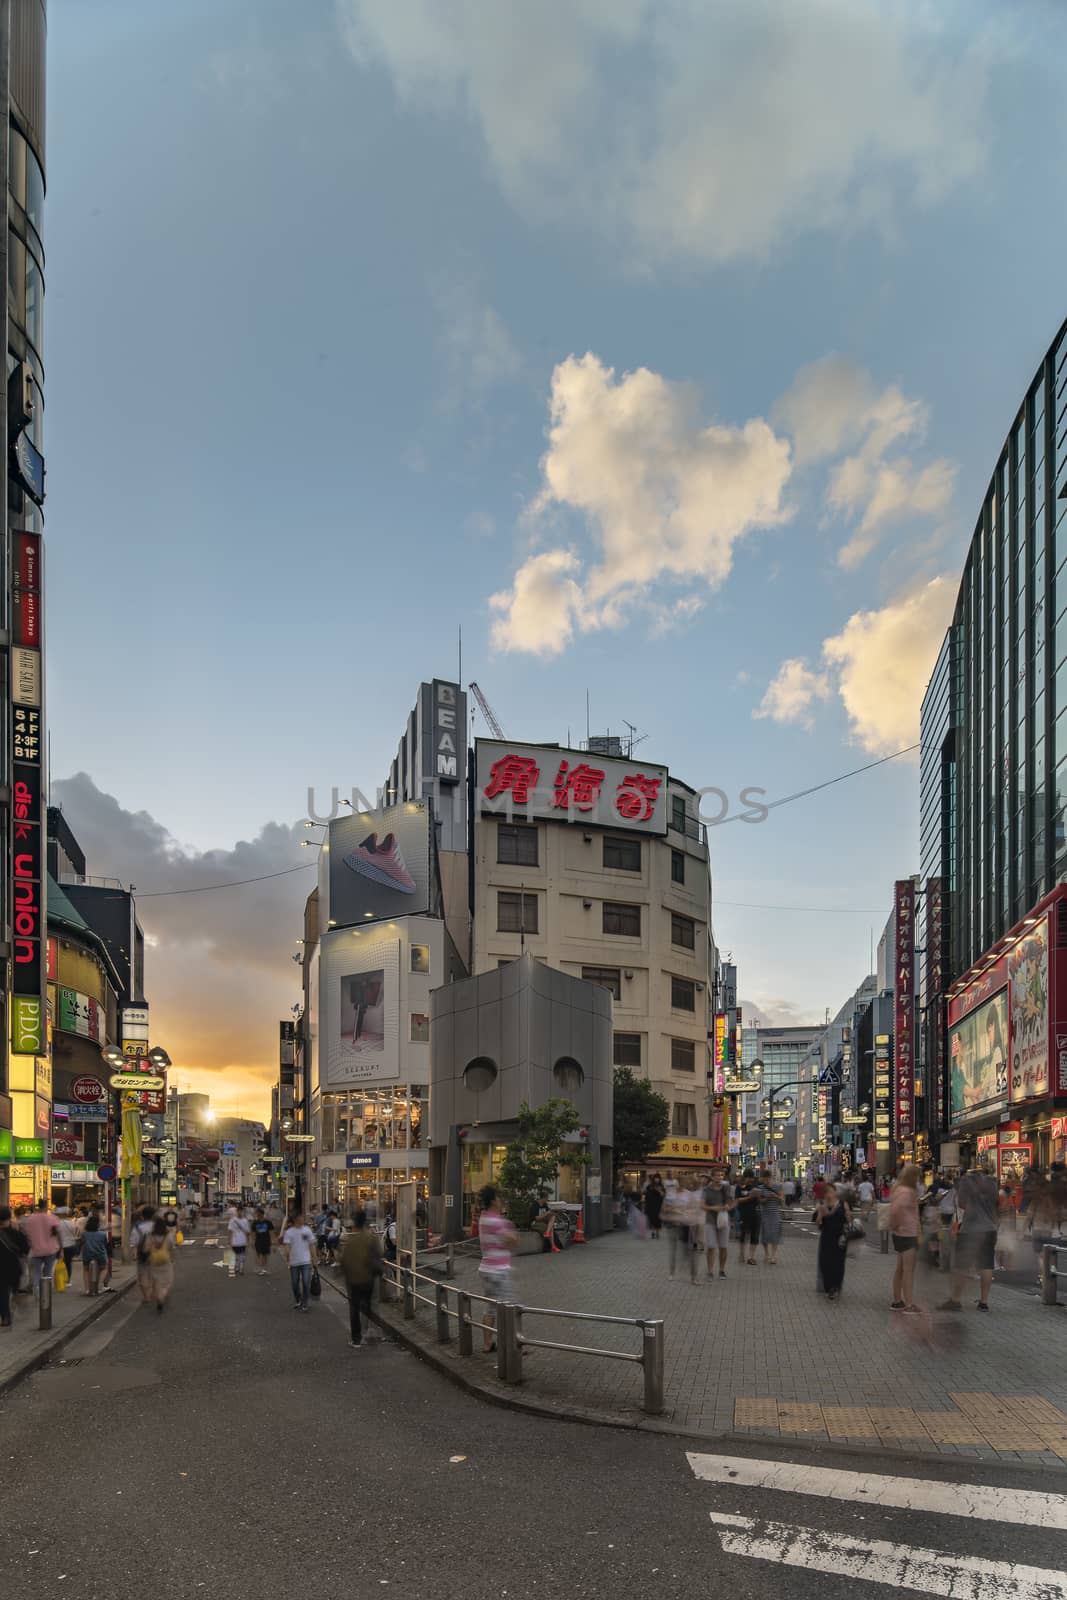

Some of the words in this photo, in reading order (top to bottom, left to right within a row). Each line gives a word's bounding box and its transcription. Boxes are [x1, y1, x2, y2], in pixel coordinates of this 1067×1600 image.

[19, 671, 34, 694] SALON
[14, 747, 39, 759] B1F
[436, 683, 457, 777] BEAM
[14, 781, 33, 840] disk
[14, 854, 35, 964] union
[19, 1000, 41, 1051] P.D.C
[77, 1086, 100, 1096] 消火栓
